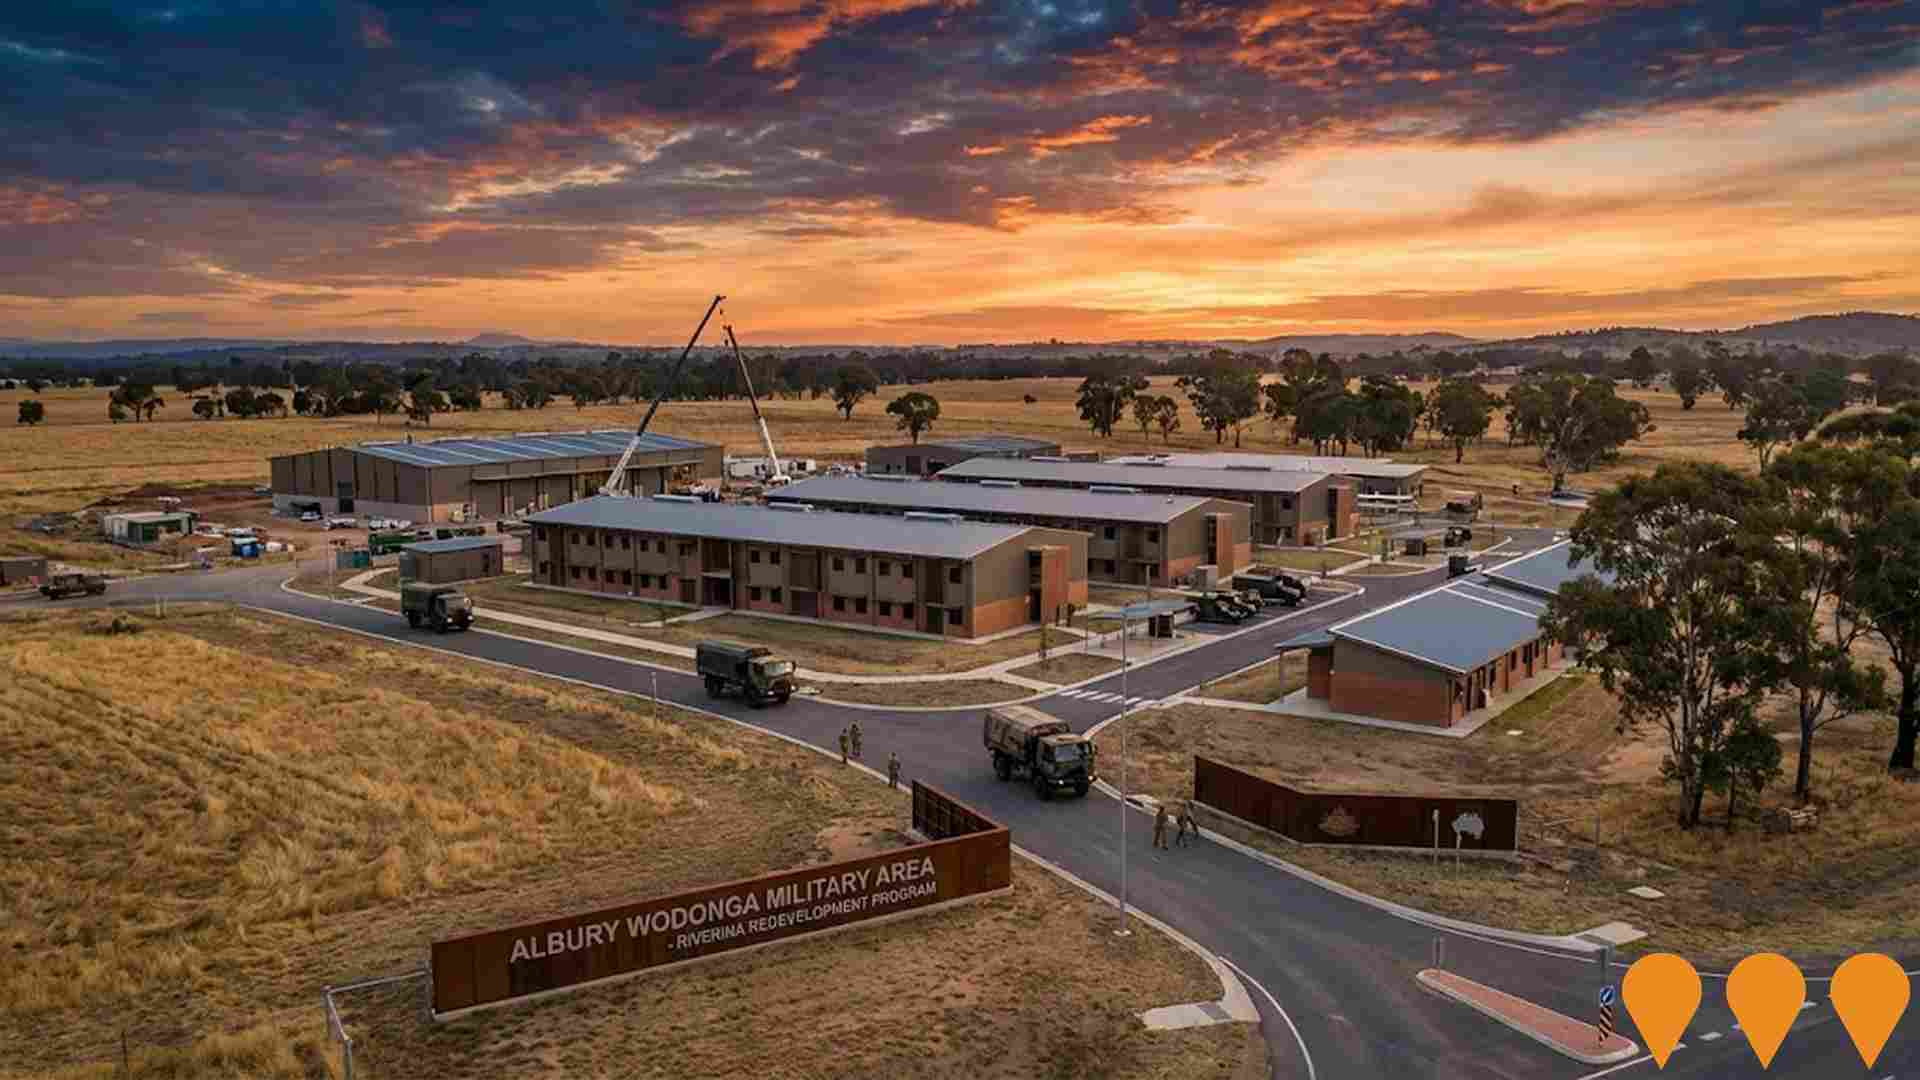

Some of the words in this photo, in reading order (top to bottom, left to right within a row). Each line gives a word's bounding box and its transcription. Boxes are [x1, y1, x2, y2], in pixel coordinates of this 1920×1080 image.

[509, 919, 621, 963] ALBURY
[626, 892, 761, 938] WODONGA
[766, 868, 872, 910] MILITARY
[875, 856, 936, 887] AREA
[676, 922, 745, 950] RIVERINA
[749, 896, 869, 932] REDEVELOPMENT
[871, 881, 937, 907] PROGRAM
